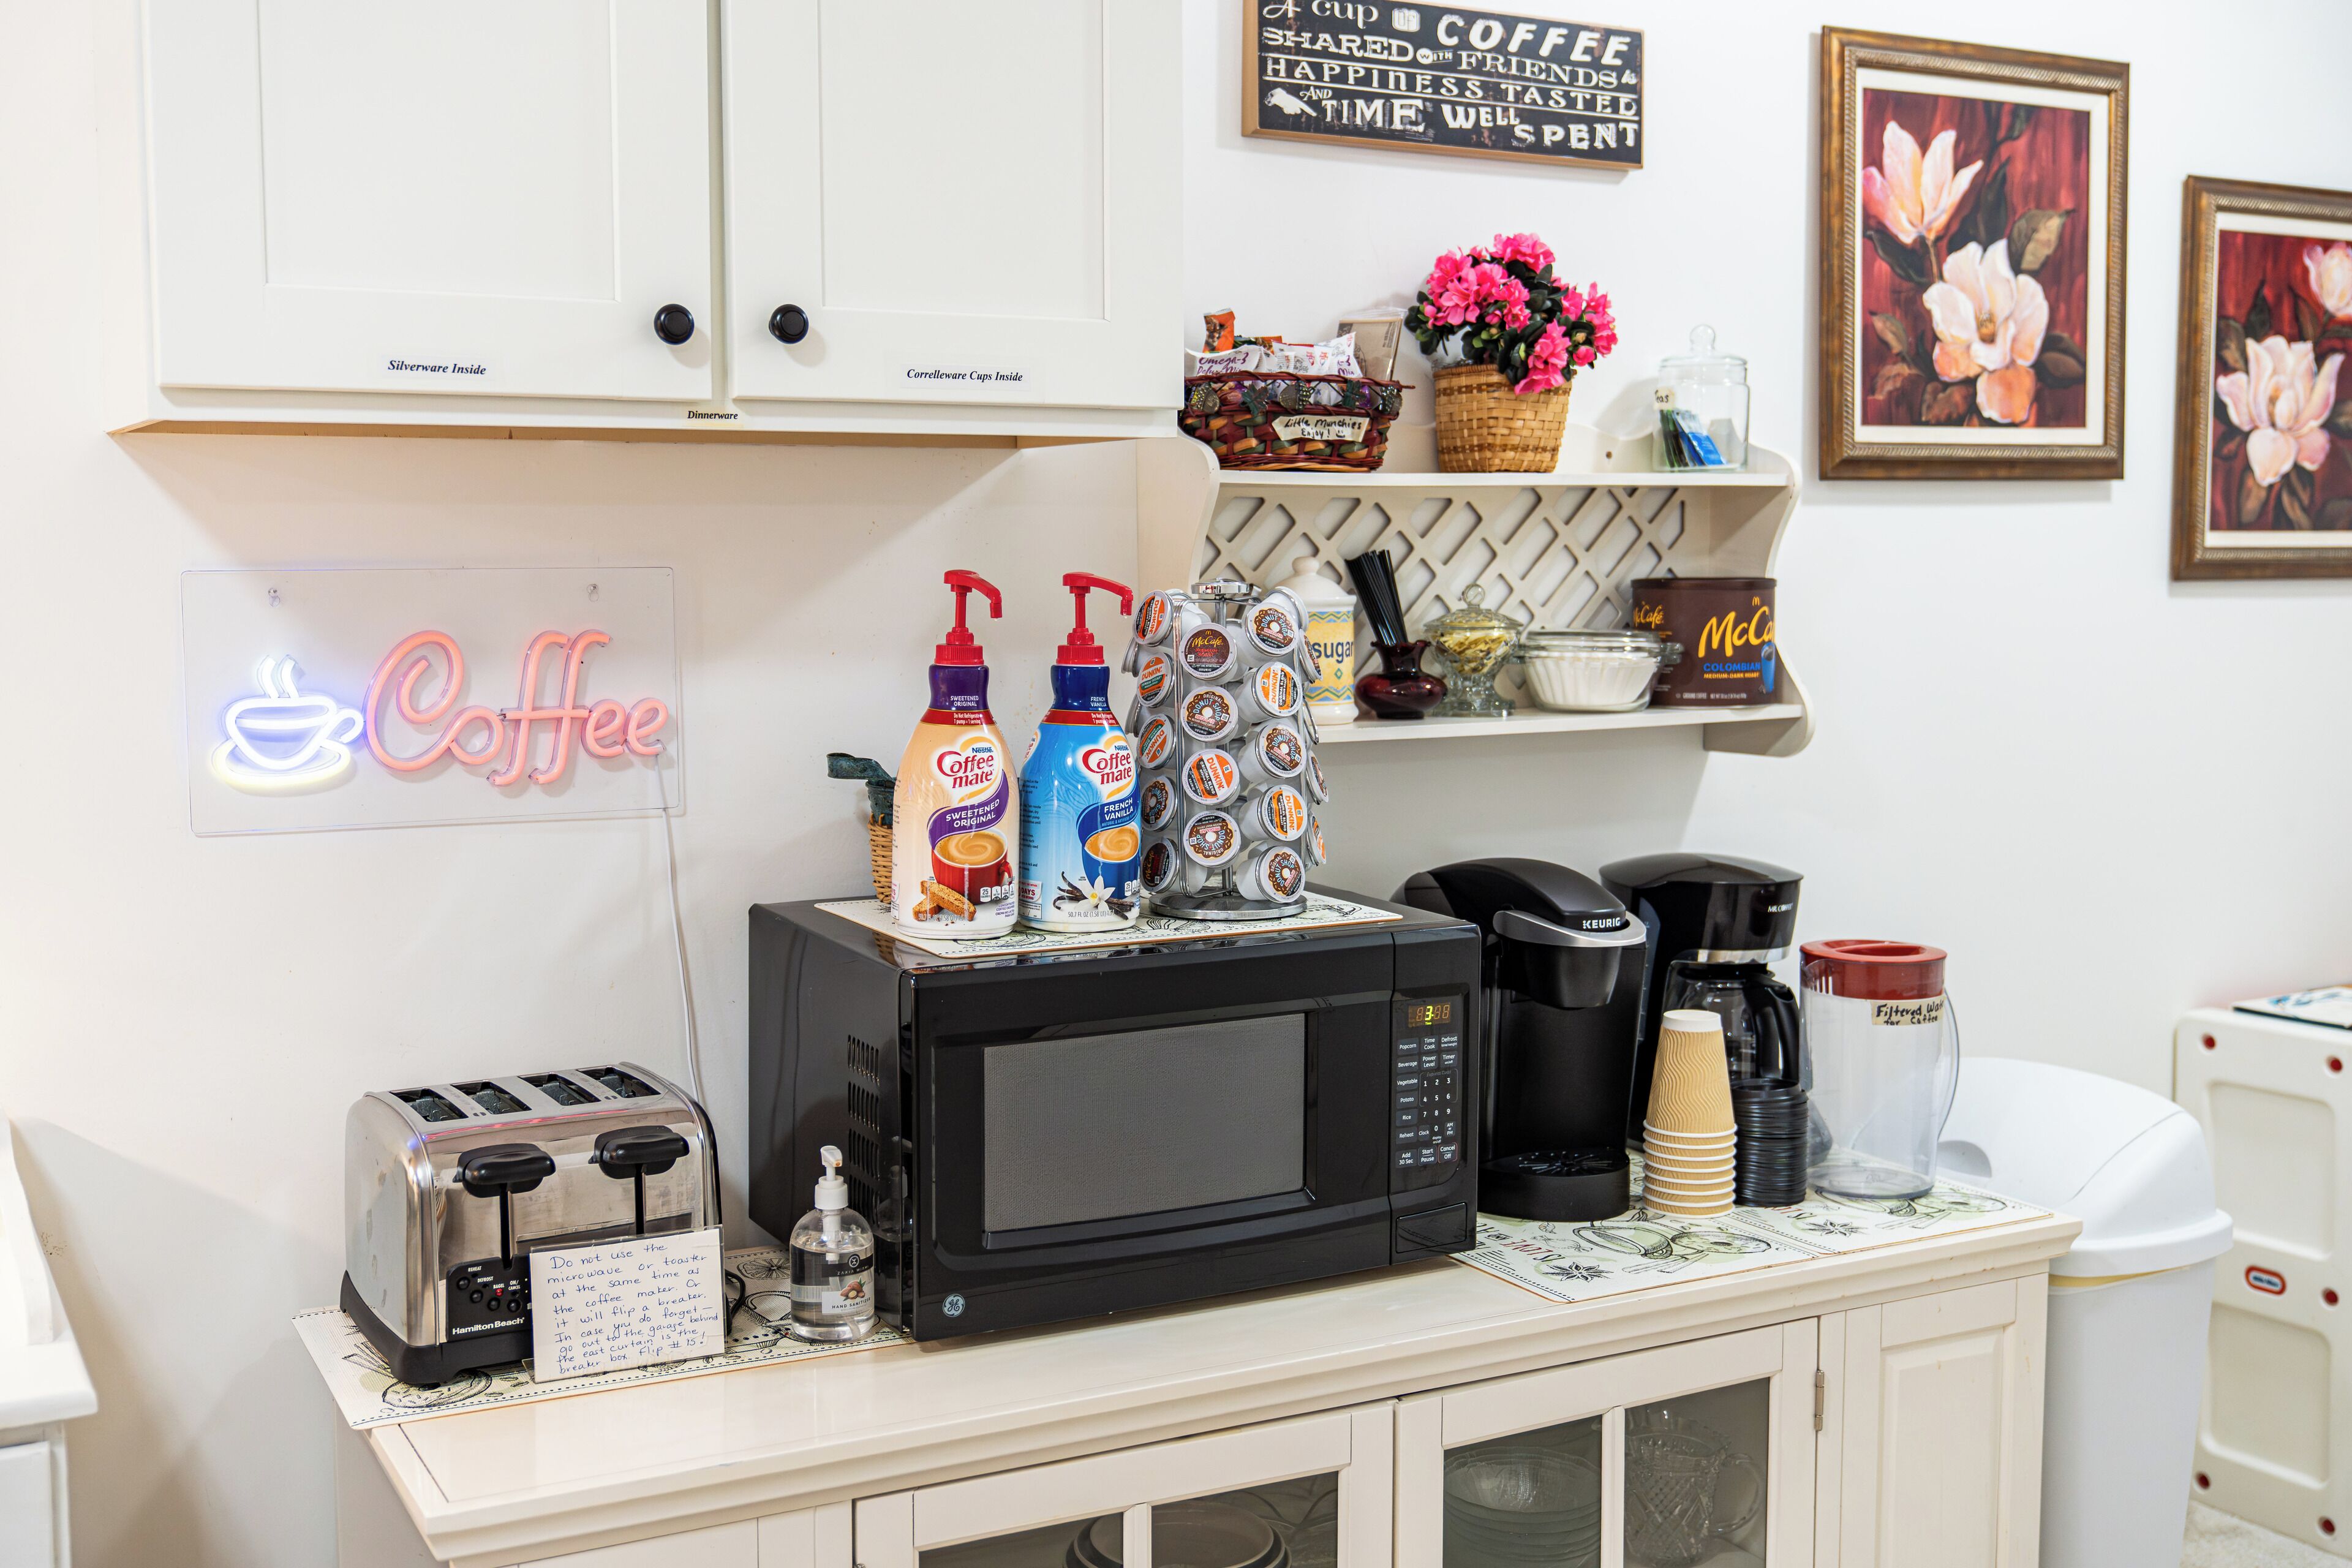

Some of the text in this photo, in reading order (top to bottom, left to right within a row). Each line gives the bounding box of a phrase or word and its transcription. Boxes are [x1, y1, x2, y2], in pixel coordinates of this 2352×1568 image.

[1311, 0, 1379, 29] cup
[1436, 13, 1630, 66] COFFEE
[1263, 27, 1414, 62] SHARED
[1458, 50, 1618, 88] FRIENDS
[1265, 57, 1637, 116] HAPPINESS TASTED
[1299, 85, 1332, 101] AND
[1321, 99, 1638, 149] TIME WELL SPENT
[388, 360, 486, 374] Silverware Inside
[907, 369, 1023, 383] Correlleware Cups Inside
[687, 410, 738, 419] Dinnerware
[1284, 417, 1362, 429] Little Munchies
[1302, 428, 1323, 439] Enjoy
[1267, 610, 1286, 620] ORIGINAL
[1261, 614, 1287, 636] DONUT SHOP
[1312, 641, 1353, 664] sugar
[1703, 662, 1761, 671] COLOMBIAN
[363, 628, 669, 786] Coffee
[1204, 695, 1223, 704] ORIGINAL
[1193, 699, 1222, 721] DONUT SHOP
[1272, 735, 1289, 747] DONUT
[937, 751, 994, 777] Coffee
[1082, 748, 1131, 773] Coffee
[952, 769, 994, 788] mate
[1100, 766, 1132, 785] mate
[1200, 761, 1210, 781] ORIGINAL
[946, 799, 1000, 821] SWEETENED
[1104, 797, 1133, 813] FRENCH
[1105, 806, 1133, 821] VANILLA
[954, 812, 995, 827] ORIGINAL
[1196, 830, 1226, 850] DONUT SHOP
[1270, 855, 1282, 872] ORIGINAL
[1275, 859, 1294, 886] DONUT SHOP
[1583, 917, 1620, 929] KEURIG
[1876, 1003, 1921, 1018] Filtered
[1910, 1014, 1937, 1024] Coffee
[550, 1244, 668, 1270] Do not use the
[548, 1267, 624, 1284] microwave
[663, 1255, 707, 1265] toaster
[552, 1289, 567, 1299] at
[576, 1284, 597, 1293] the
[608, 1278, 642, 1288] same
[652, 1270, 680, 1280] time
[554, 1279, 701, 1315] the coffee maker. Or
[850, 1297, 870, 1306] SANITIZER
[556, 1320, 569, 1329] it
[580, 1310, 603, 1324] will
[611, 1306, 636, 1318] flip
[658, 1294, 707, 1307] breaker.
[453, 1317, 524, 1335] Hamilton Beach
[555, 1306, 698, 1343] In case you do forget
[560, 1345, 573, 1357] go
[582, 1338, 600, 1348] out
[624, 1327, 644, 1337] the
[649, 1321, 685, 1338] garage
[690, 1314, 718, 1324] behind
[557, 1327, 699, 1364] the east curtain is the
[559, 1360, 601, 1374] breaker
